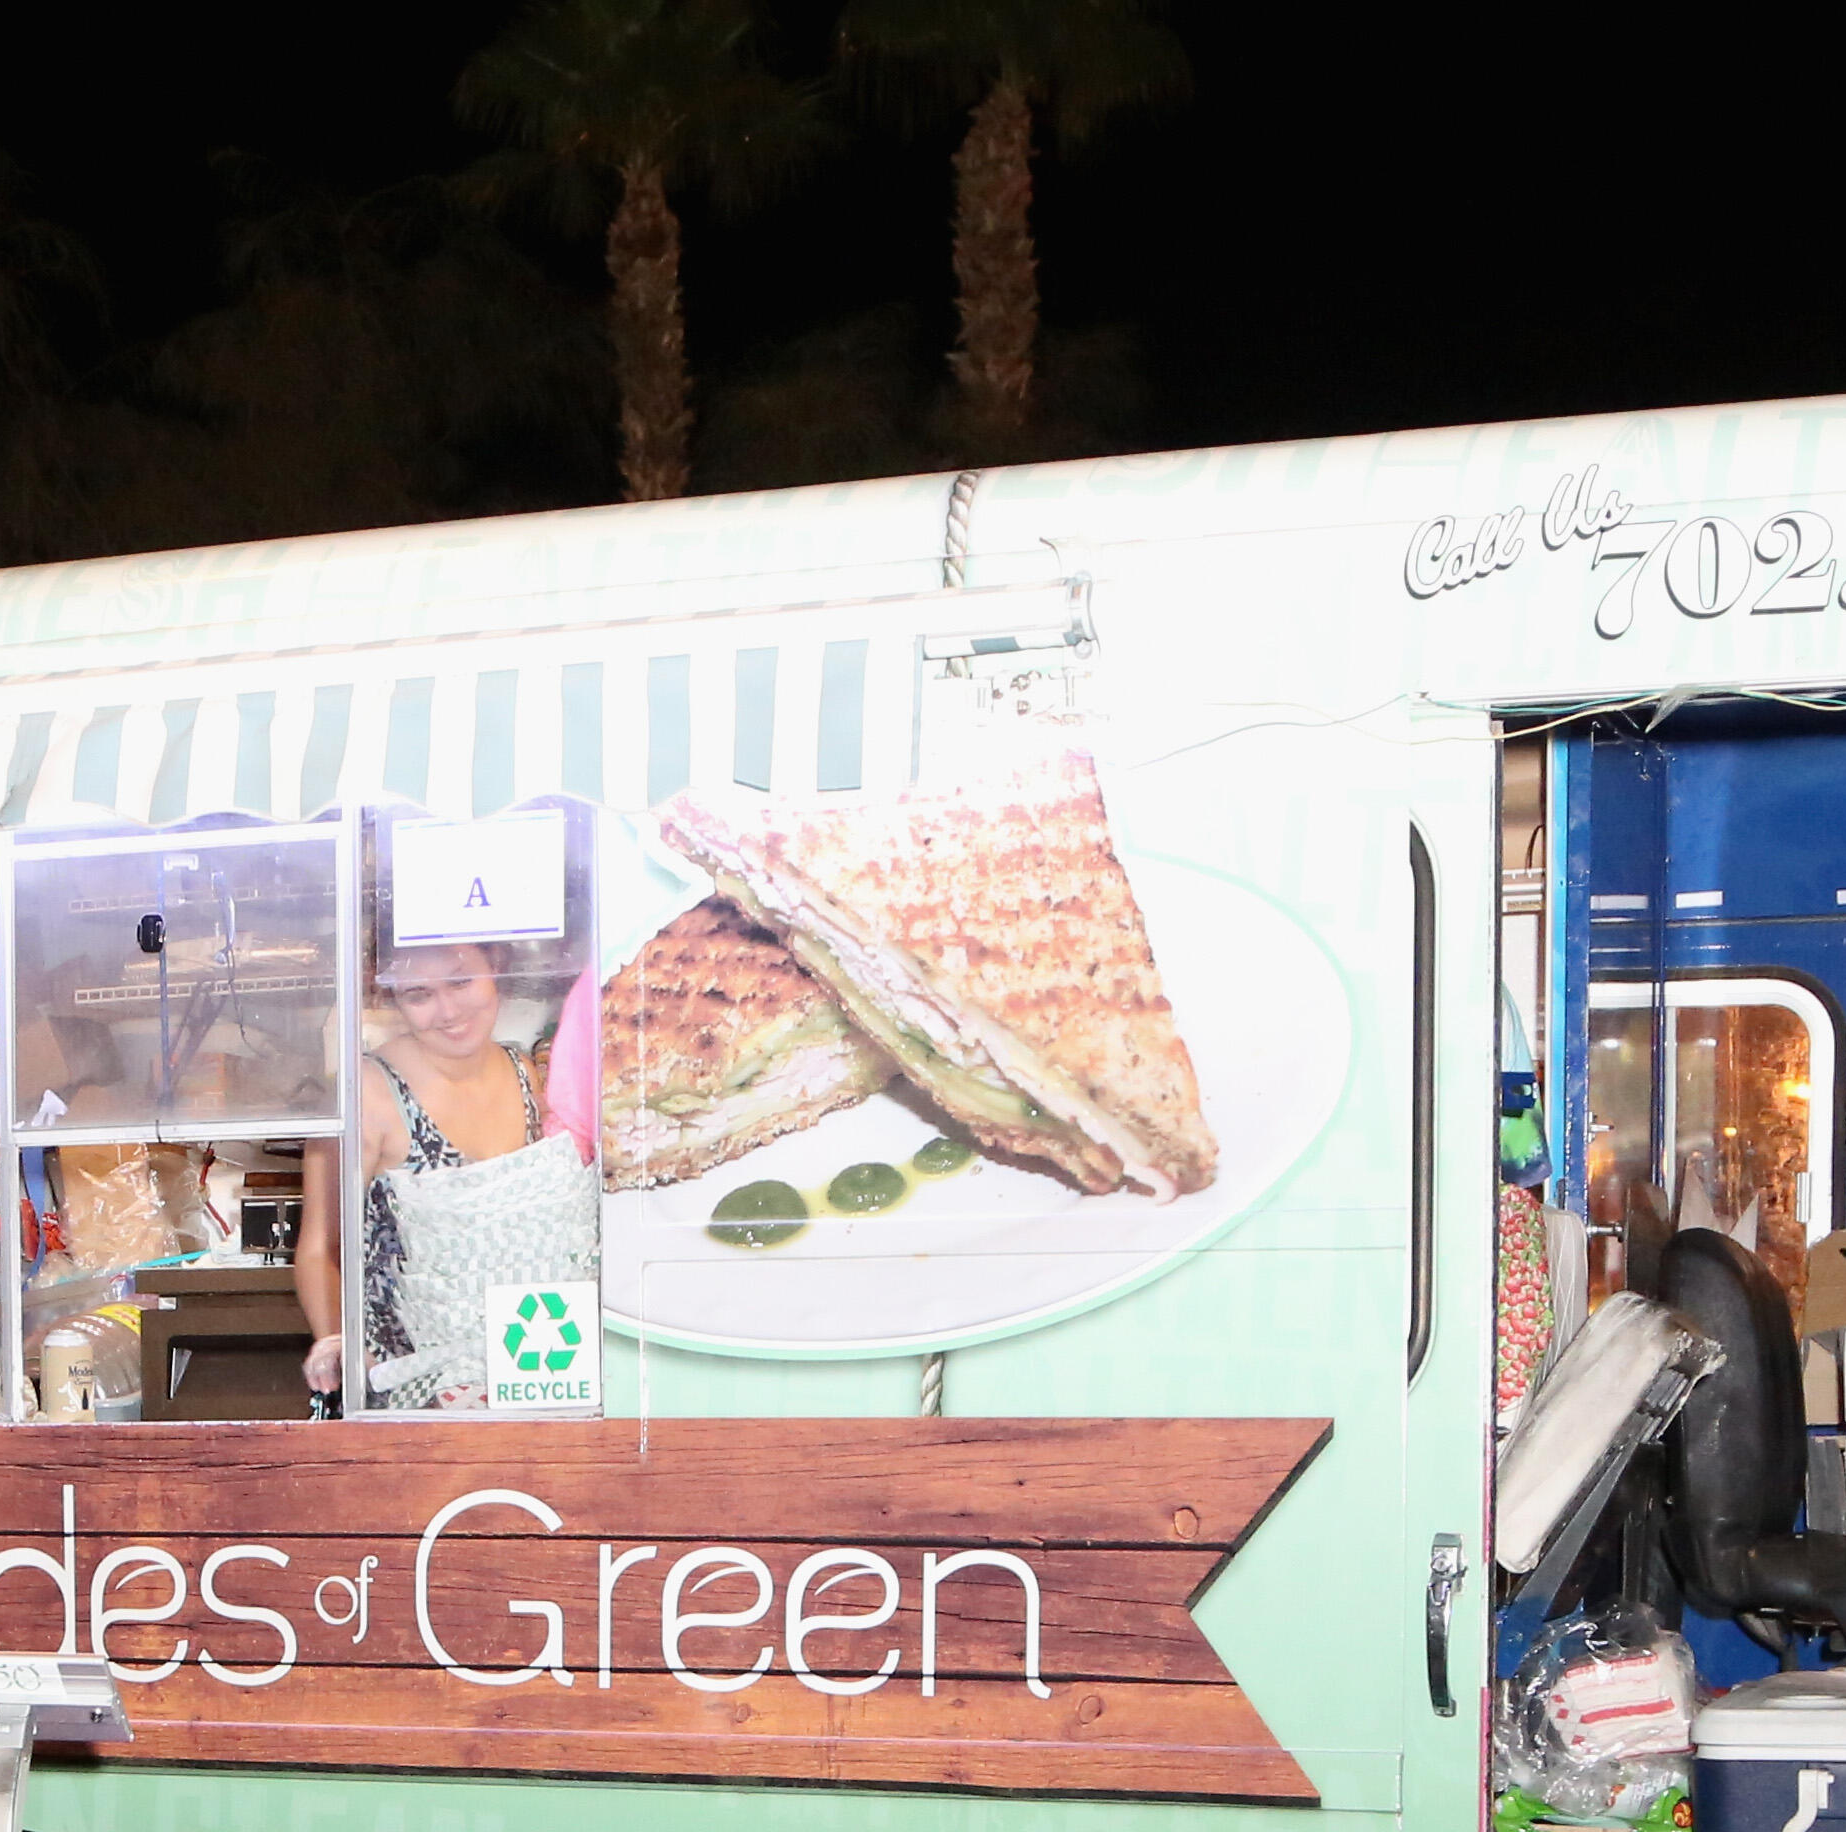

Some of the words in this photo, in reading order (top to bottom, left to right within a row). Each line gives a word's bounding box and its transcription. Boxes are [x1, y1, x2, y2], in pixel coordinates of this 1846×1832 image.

[1404, 502, 1525, 600] Call
[1541, 463, 1637, 553] Us
[462, 876, 492, 908] A
[496, 1380, 590, 1403] RECYCLE
[314, 1554, 379, 1645] of
[414, 1488, 1052, 1700] Green
